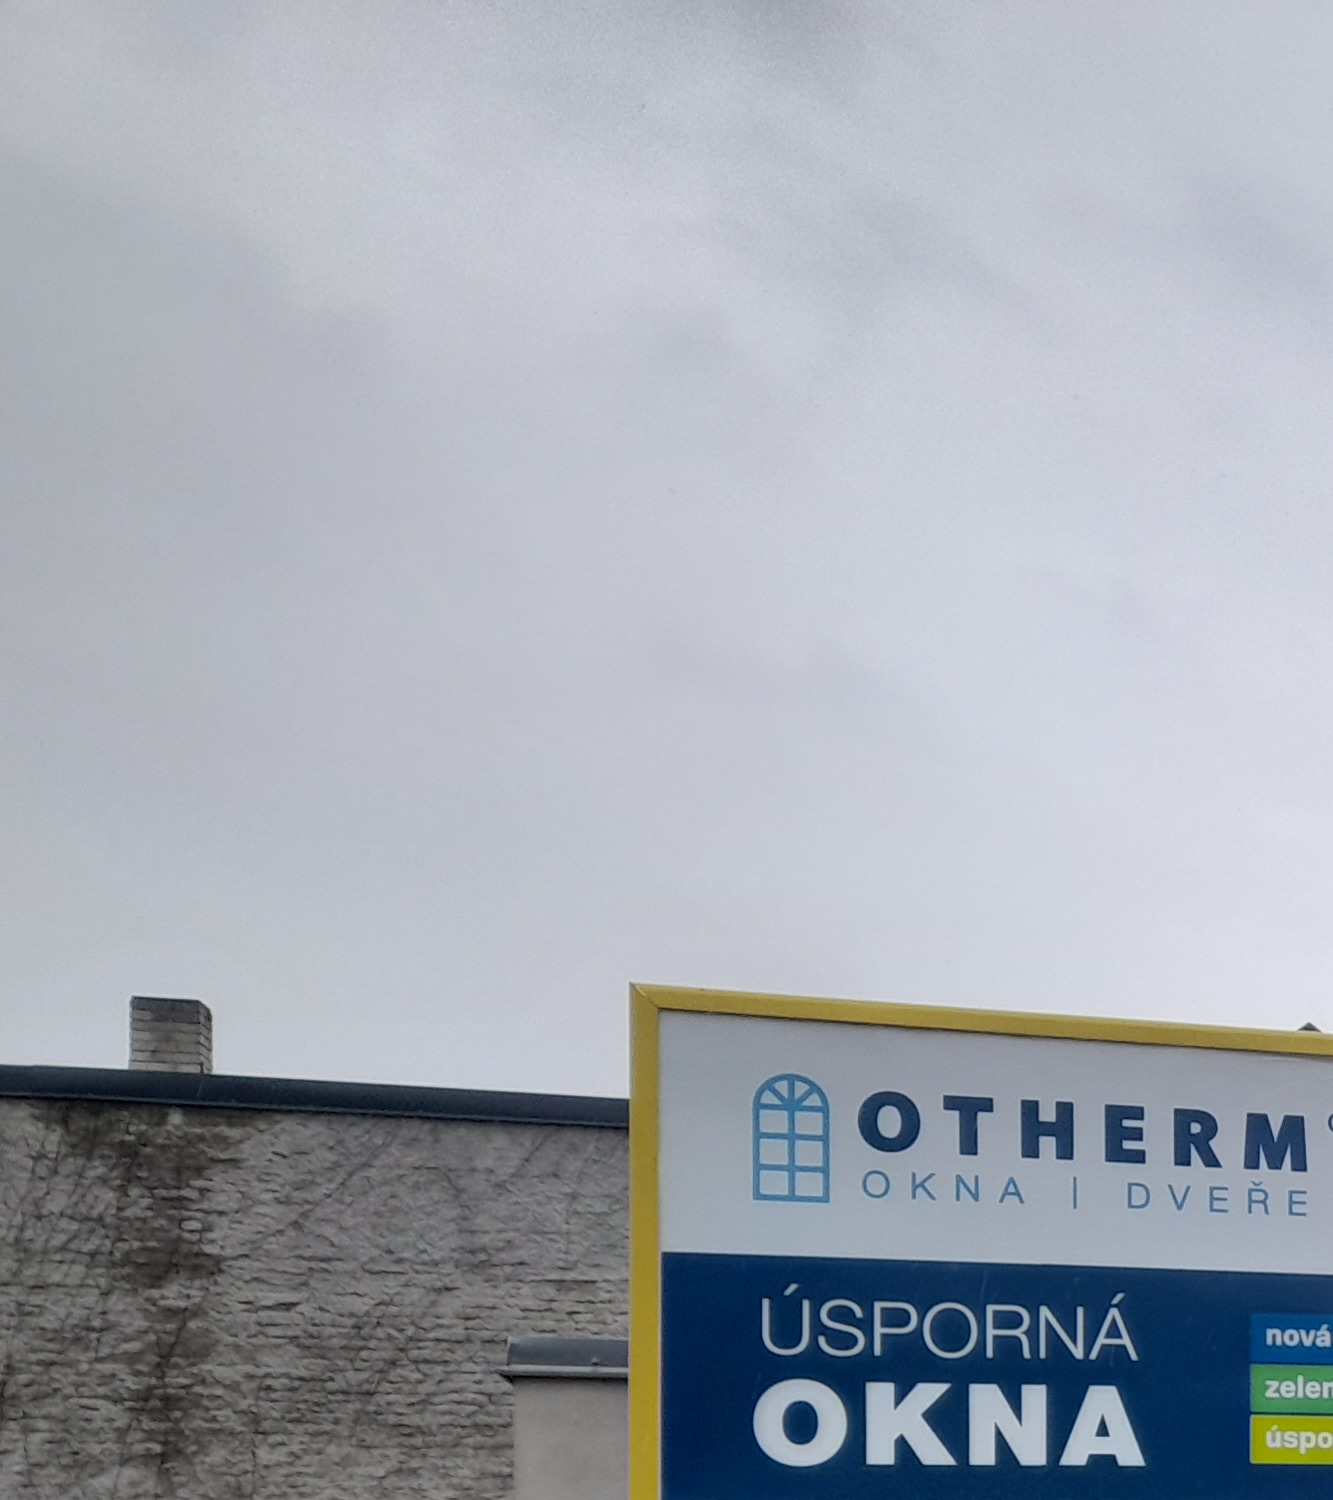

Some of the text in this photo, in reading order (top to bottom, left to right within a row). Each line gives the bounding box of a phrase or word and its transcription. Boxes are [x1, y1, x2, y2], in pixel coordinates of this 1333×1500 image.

[861, 1169, 1308, 1217] OKNA DVEŘE
[761, 1283, 1139, 1361] ÚSPORNÁ
[1265, 1322, 1333, 1350] nová
[752, 1378, 1147, 1467] OKNA
